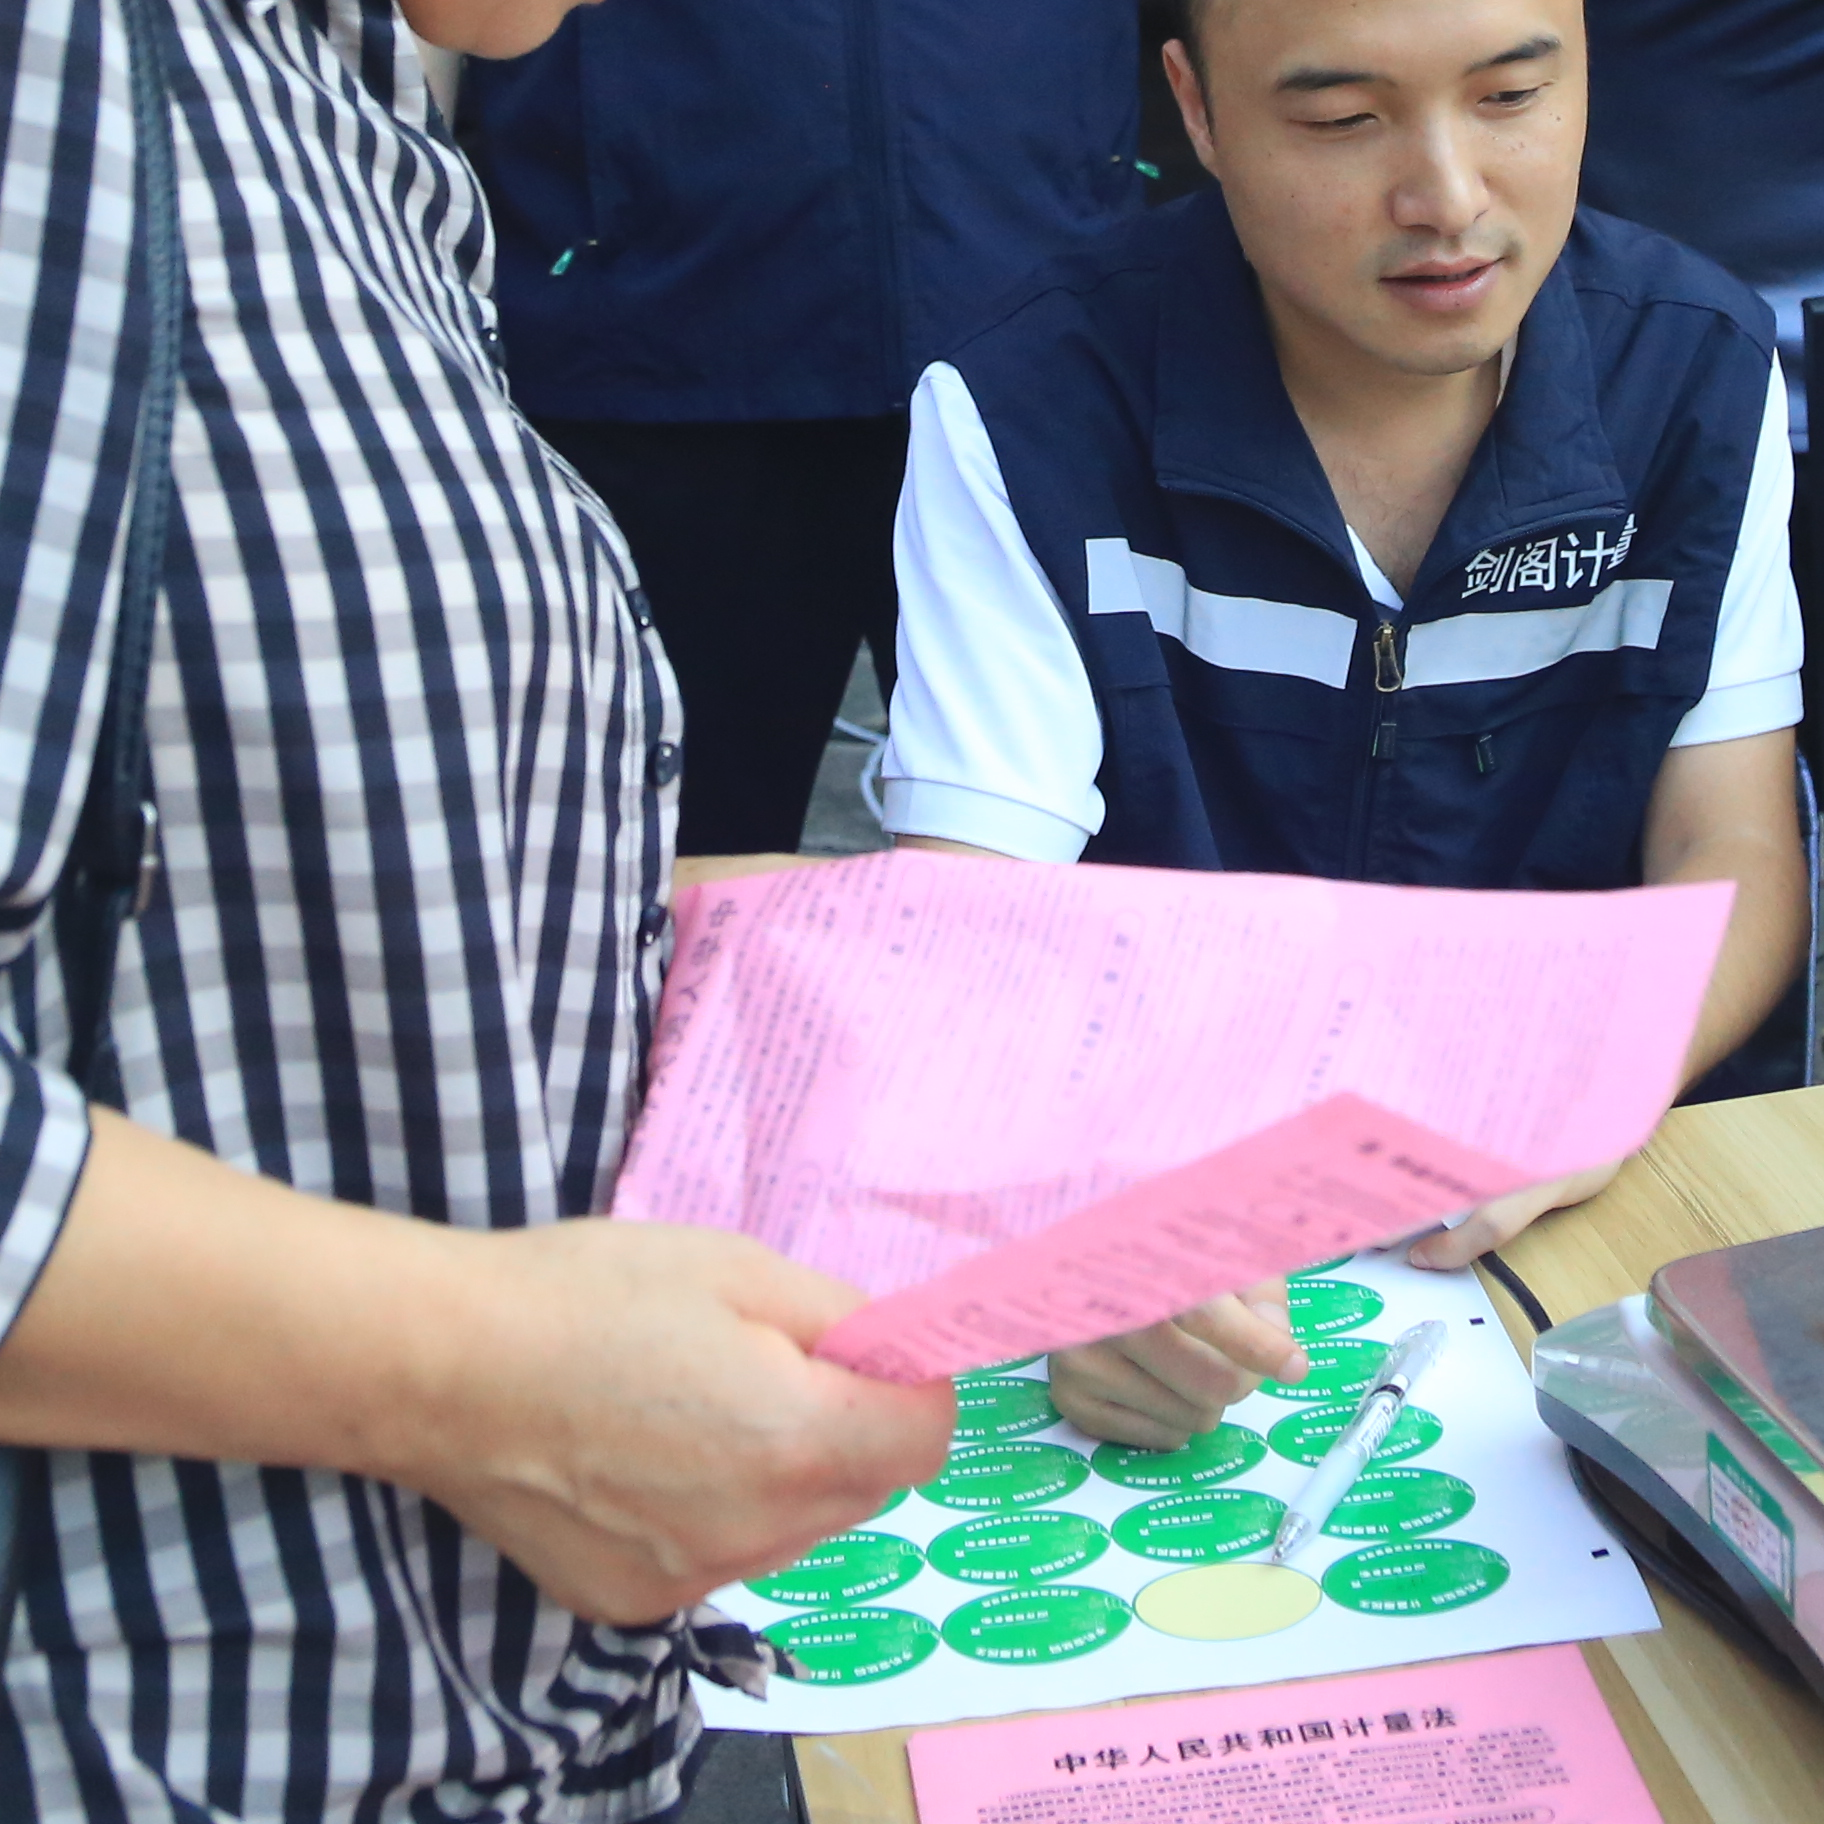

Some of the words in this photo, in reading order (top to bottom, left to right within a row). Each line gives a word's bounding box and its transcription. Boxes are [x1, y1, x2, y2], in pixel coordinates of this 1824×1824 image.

[1054, 1707, 1457, 1775] 中华人民共和国计量法
